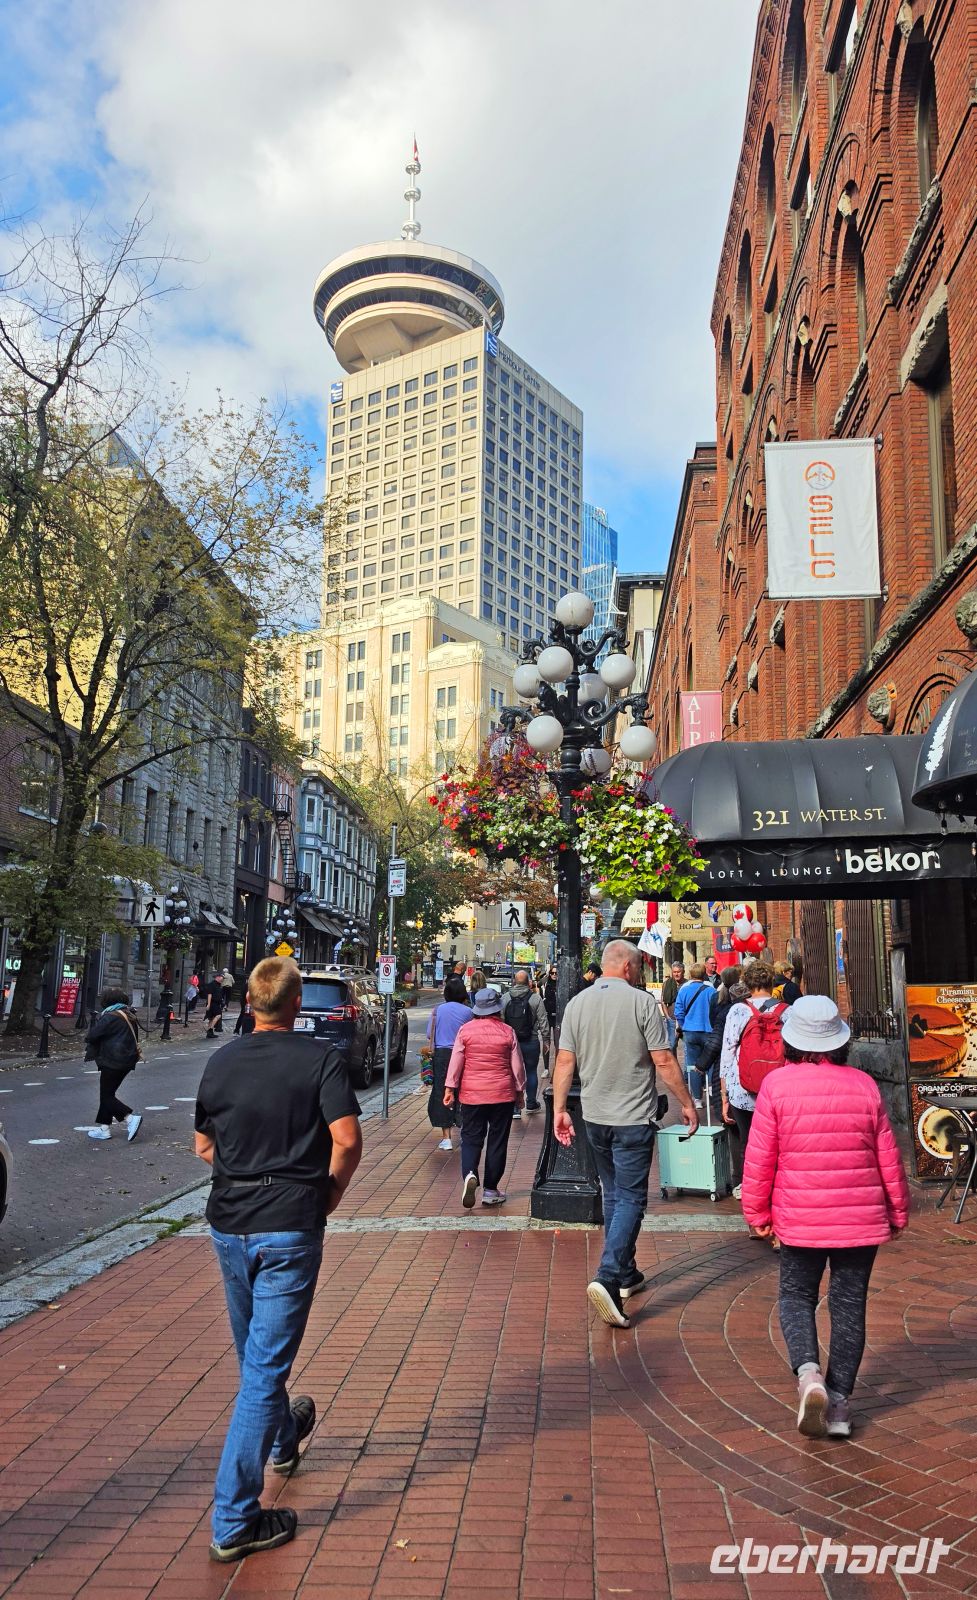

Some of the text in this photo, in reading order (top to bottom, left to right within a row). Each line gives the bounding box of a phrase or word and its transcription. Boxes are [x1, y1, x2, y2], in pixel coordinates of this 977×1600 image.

[752, 808, 887, 831] 321 WATER ST.
[709, 870, 744, 880] LOFT
[771, 866, 833, 878] LOUNGE
[940, 987, 975, 996] Tiramisu
[917, 1085, 950, 1093] ORGANIC
